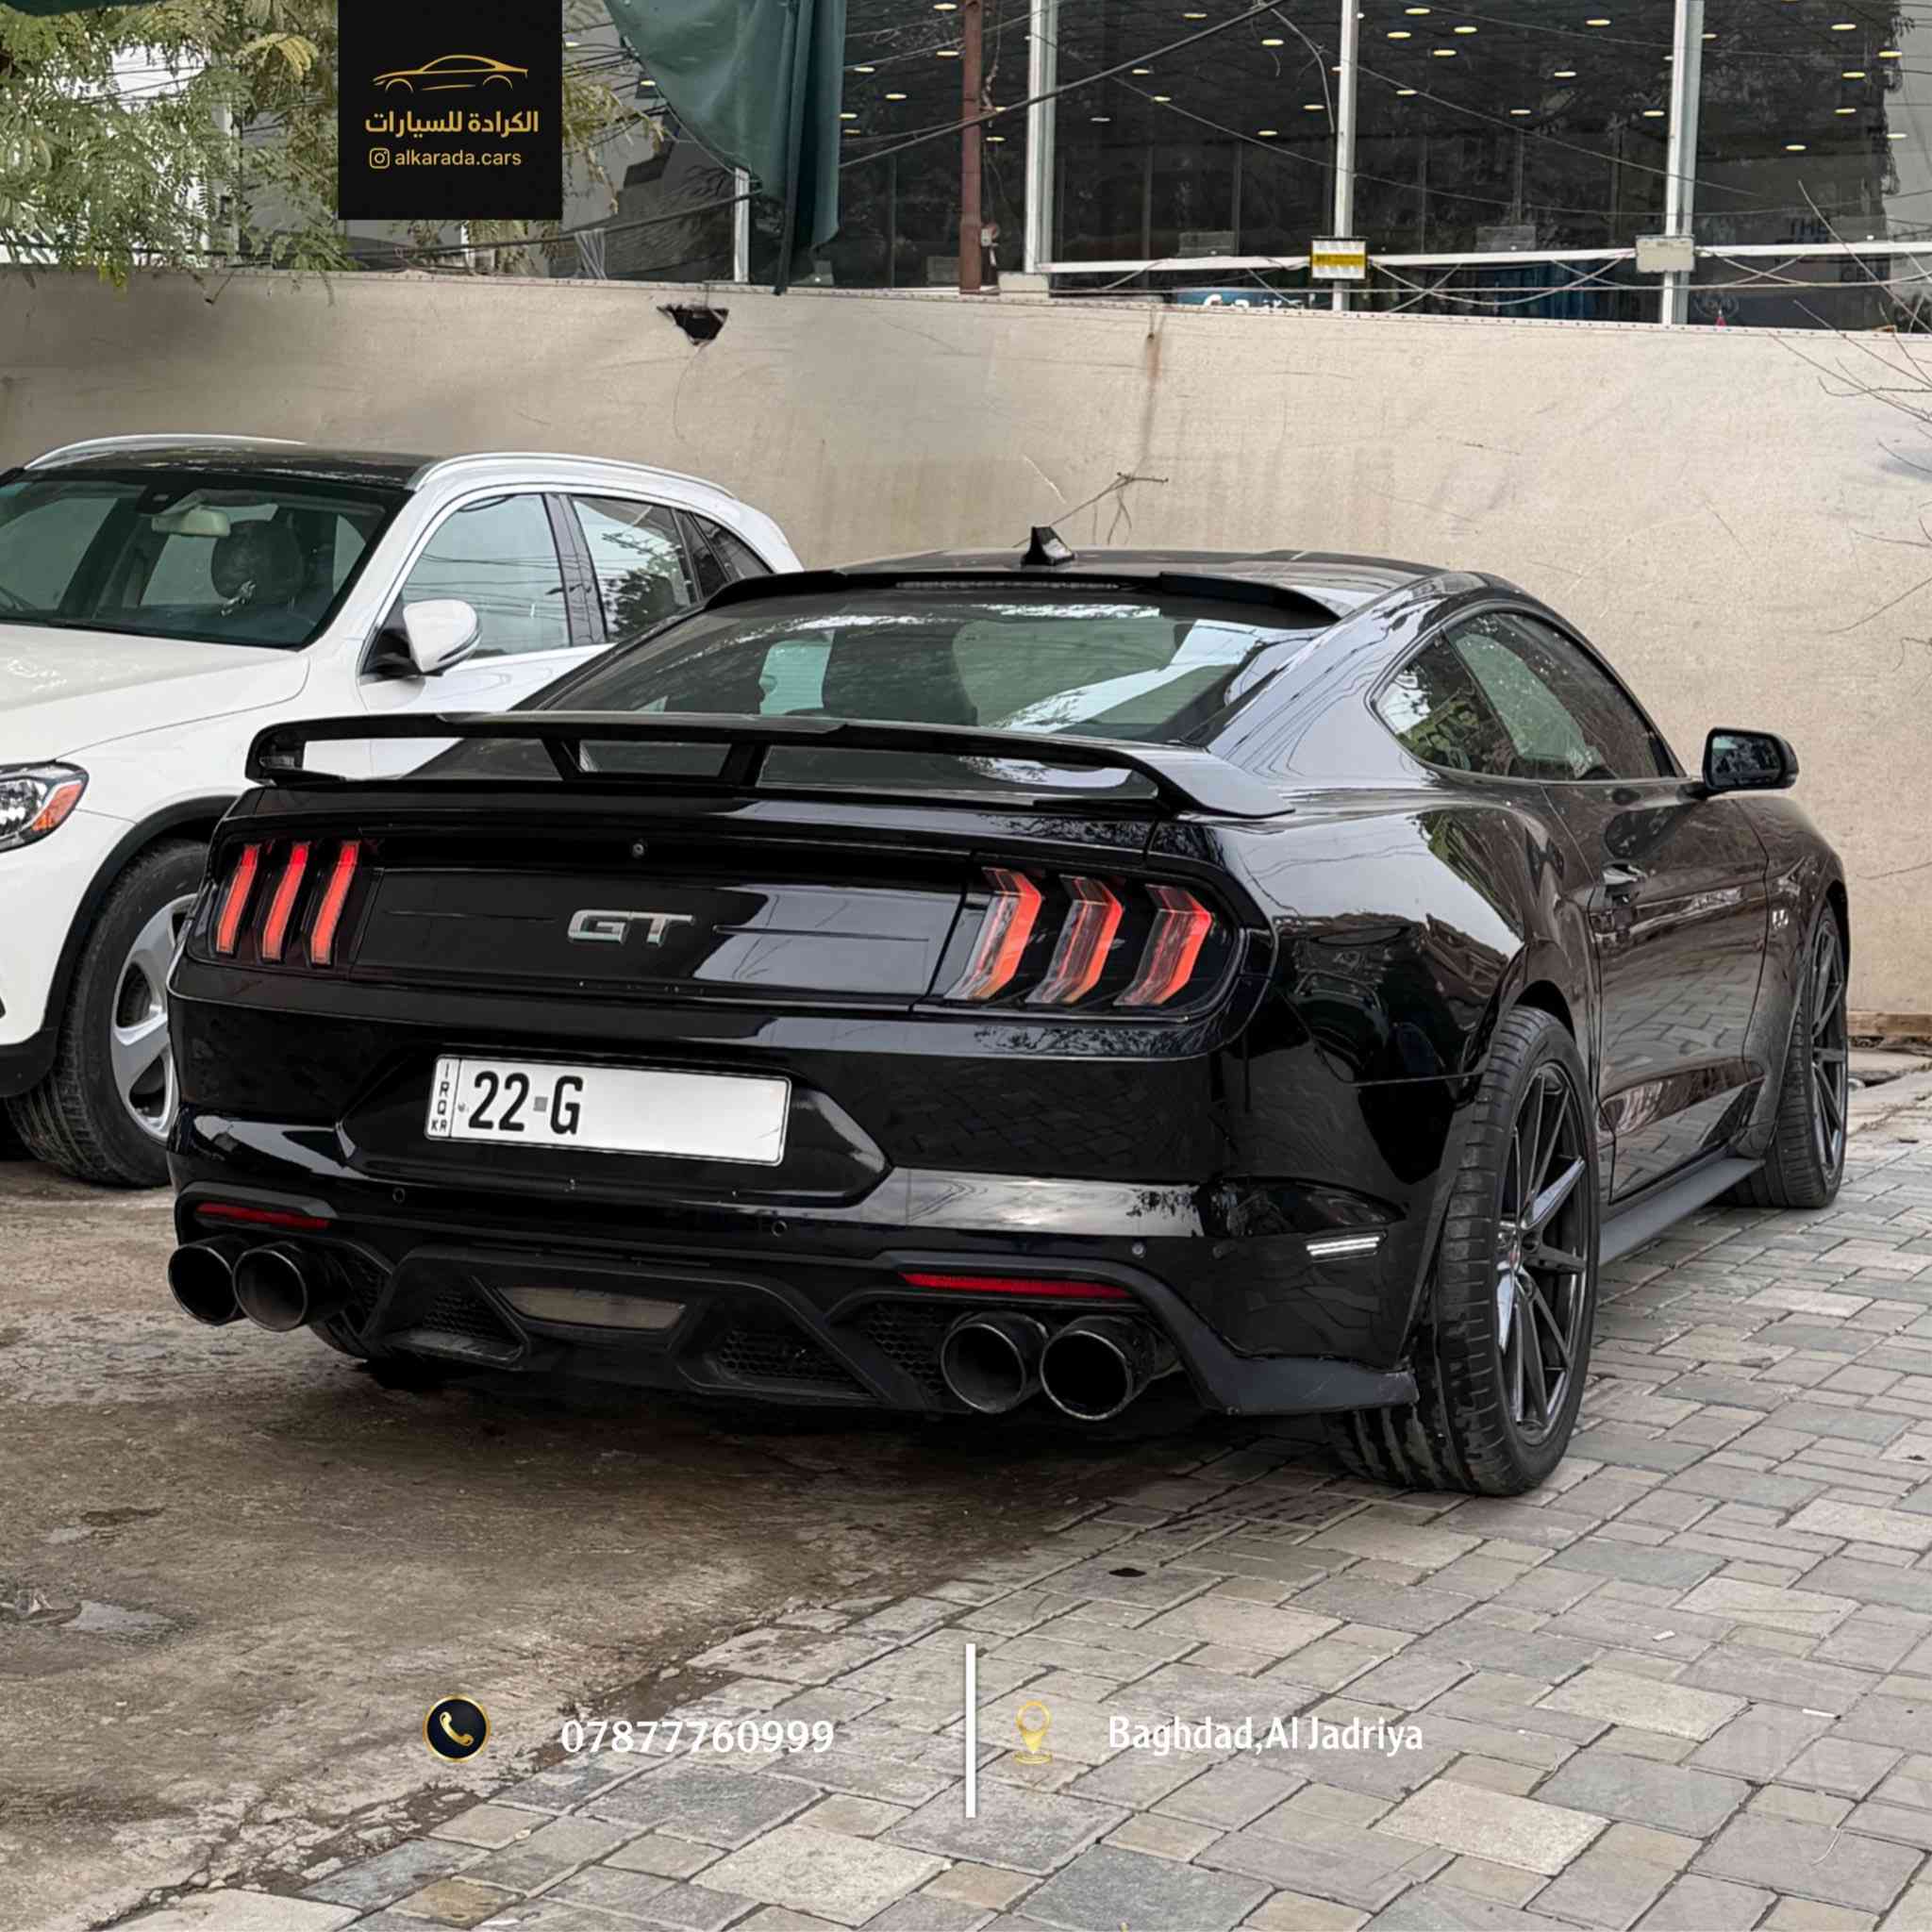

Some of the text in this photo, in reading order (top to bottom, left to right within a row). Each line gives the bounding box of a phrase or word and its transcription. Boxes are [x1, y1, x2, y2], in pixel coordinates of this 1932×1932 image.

[567, 908, 695, 945] GT
[468, 1070, 584, 1136] 22 G
